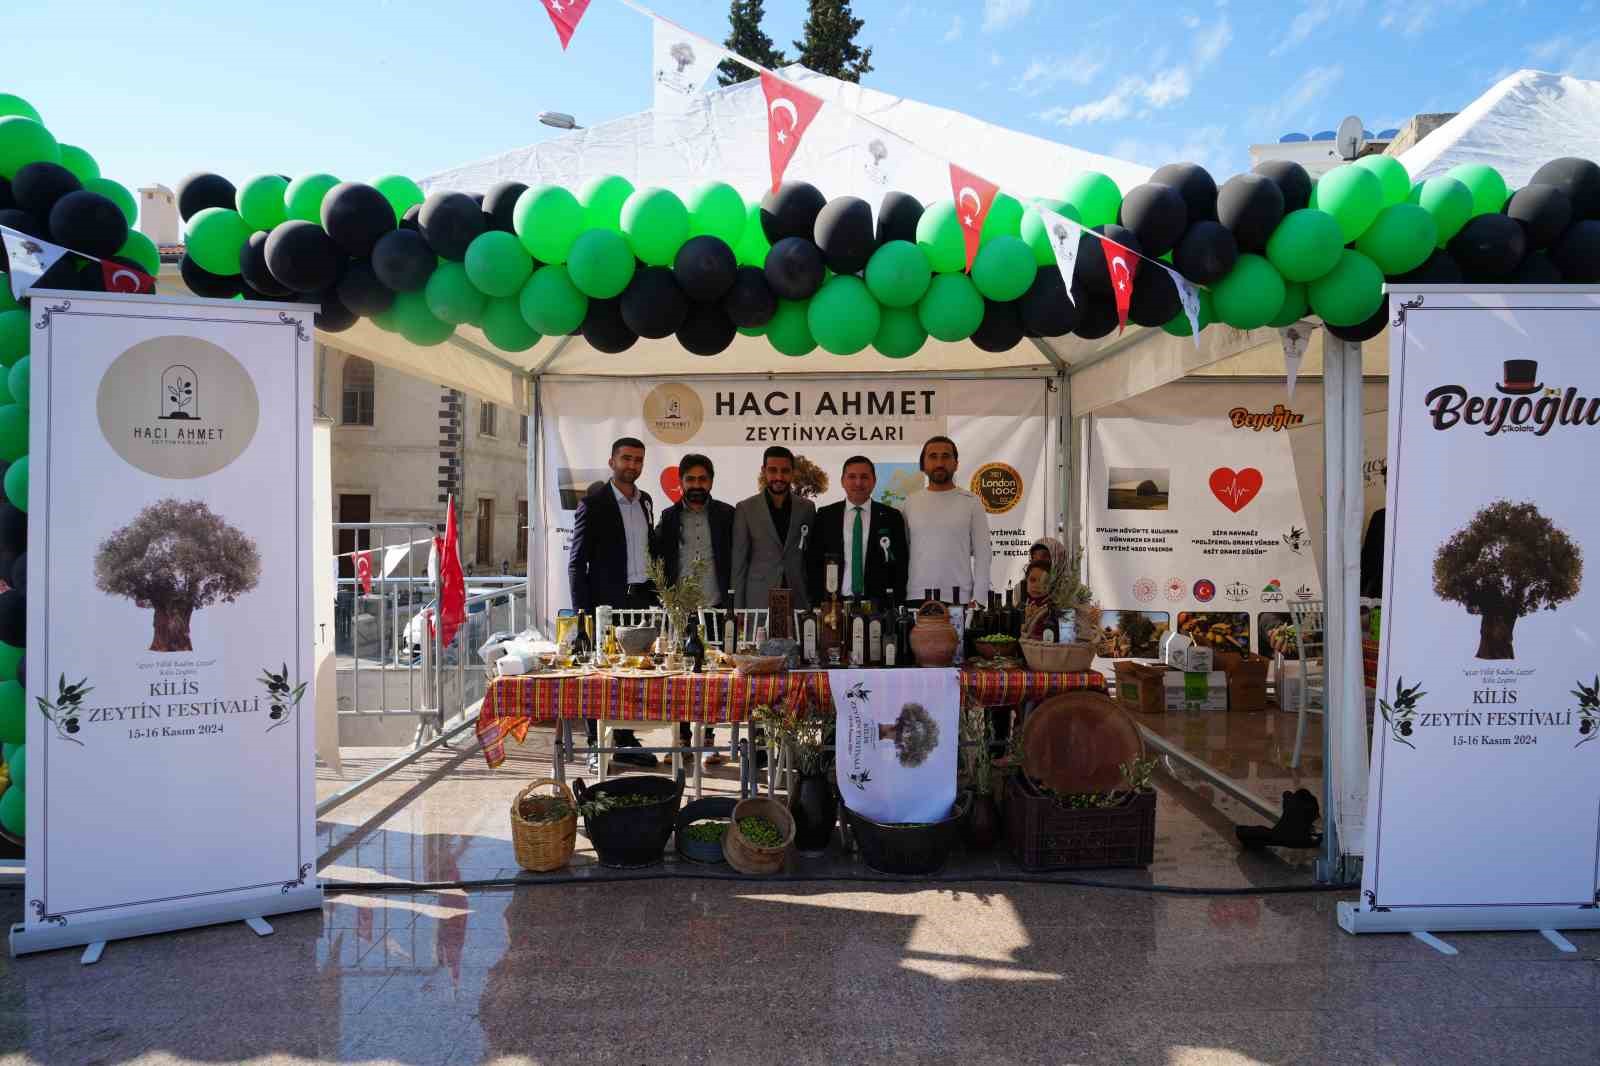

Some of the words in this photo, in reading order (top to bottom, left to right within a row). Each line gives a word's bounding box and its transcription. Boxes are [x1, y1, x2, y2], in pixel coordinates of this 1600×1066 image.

[715, 391, 801, 416] HACI
[815, 390, 936, 416] AHMET
[134, 427, 168, 439] HACI
[177, 427, 224, 441] AHMET
[745, 423, 904, 441] ZEYTİNYAĞLARI
[982, 479, 1016, 488] London
[149, 678, 200, 697] KİLİS
[1472, 687, 1518, 704] KİLİS
[88, 702, 162, 723] ZEYTİN
[167, 696, 261, 718] FESTİVALİ
[1420, 709, 1481, 727] ZEYTİN
[1486, 708, 1571, 726] FESTİVALİ
[127, 728, 159, 740] 15-16
[161, 726, 196, 738] Kasım
[198, 724, 224, 735] 2024
[1452, 735, 1479, 746] 15-16
[1481, 735, 1511, 745] Kasım
[1513, 735, 1537, 745] 2024
